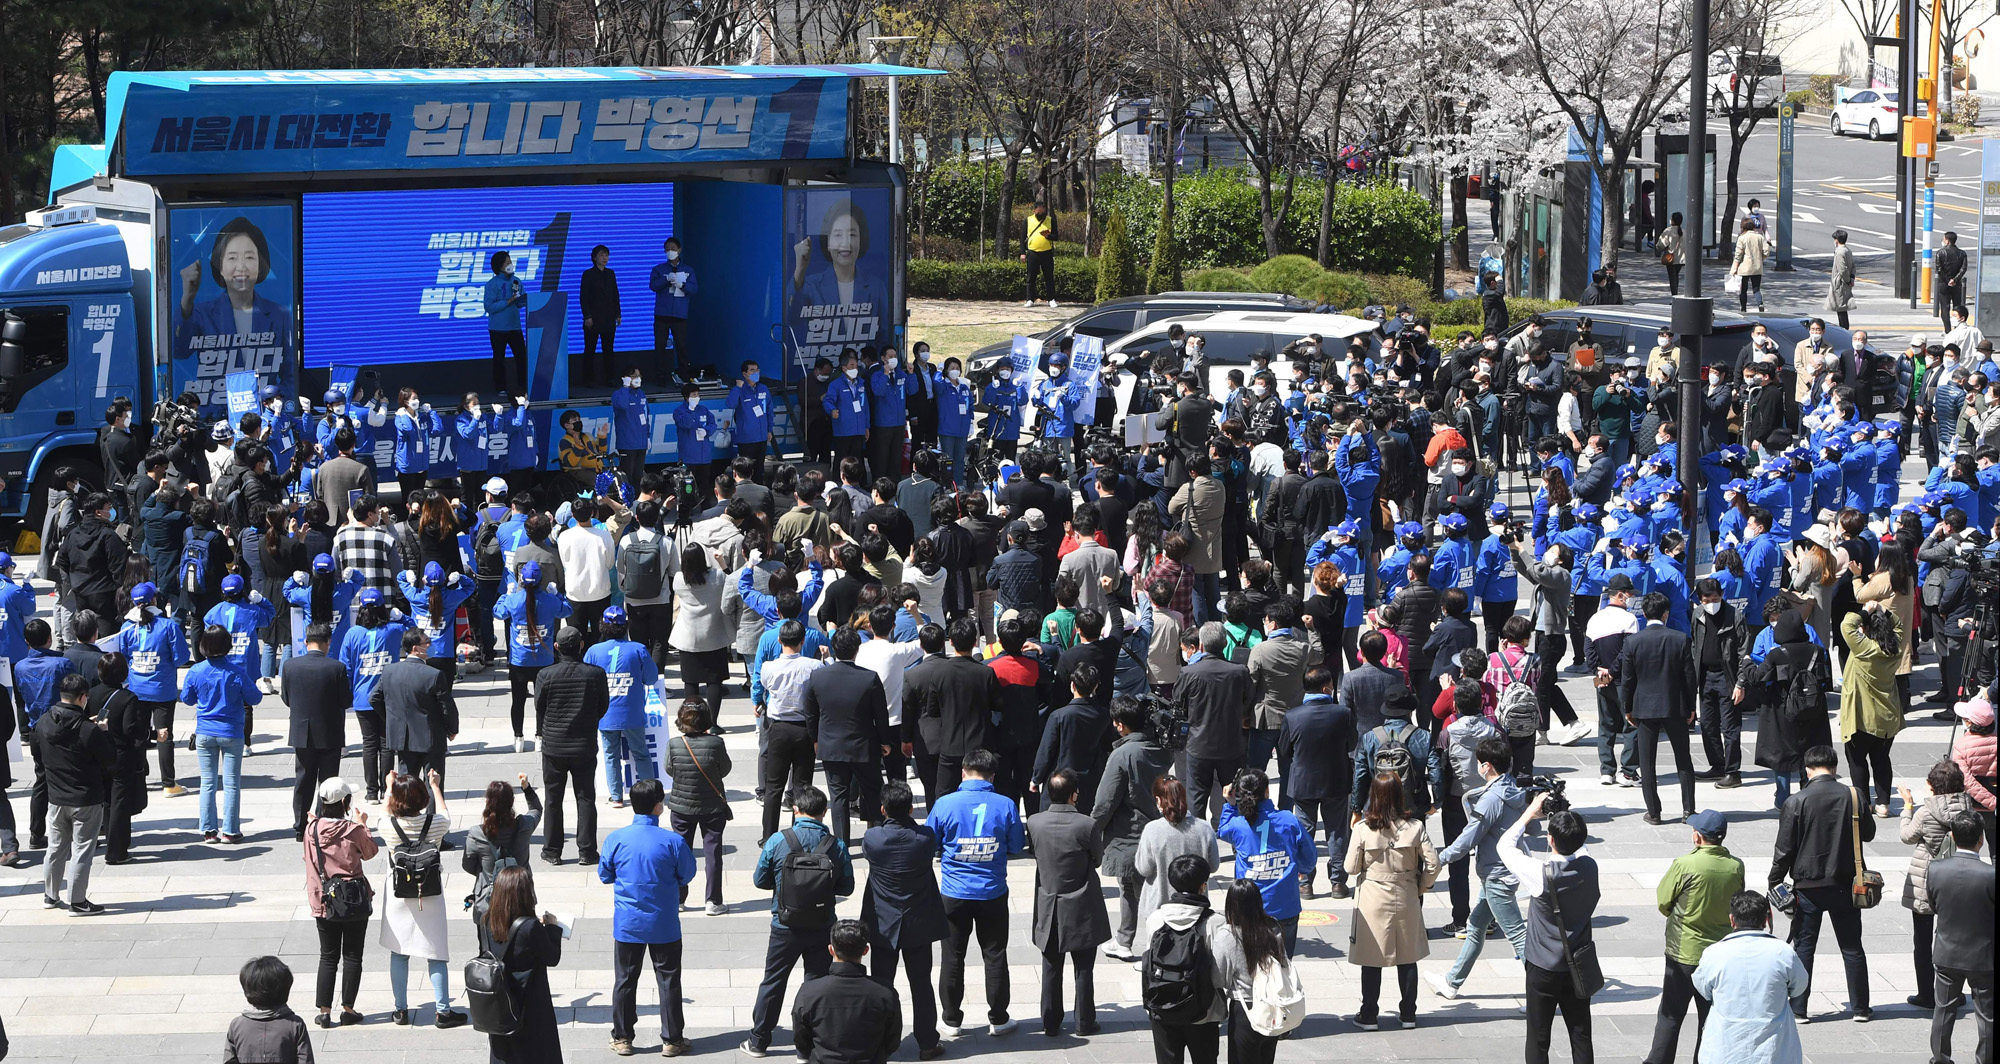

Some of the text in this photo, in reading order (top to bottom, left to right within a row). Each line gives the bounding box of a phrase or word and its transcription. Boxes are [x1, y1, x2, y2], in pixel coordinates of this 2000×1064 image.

[151, 78, 826, 159] 서울시 대전환 합니다 박영선 1
[427, 229, 530, 249] 서울시 대전환
[534, 212, 571, 292] 1
[36, 265, 122, 285] 서울시 대전환
[87, 304, 121, 318] 합니다
[419, 286, 489, 319] 박영
[800, 302, 872, 318] 서울시 대전환
[83, 318, 115, 331] 박영선
[805, 316, 879, 344] 합니다
[189, 332, 275, 349] 서울시 대전환
[528, 291, 568, 401] 1
[92, 331, 114, 398] 1
[197, 347, 283, 377] 합니다
[1074, 355, 1097, 365] 합니다
[512, 529, 522, 551] 1
[1463, 543, 1469, 566] 1
[225, 606, 235, 633] 1
[231, 637, 250, 646] 니다
[366, 630, 377, 653] 1
[608, 646, 620, 673] 1
[972, 803, 987, 837] 1
[1256, 820, 1270, 853] 1
[961, 842, 1000, 855] 합니다
[1252, 856, 1290, 871] 합니다
